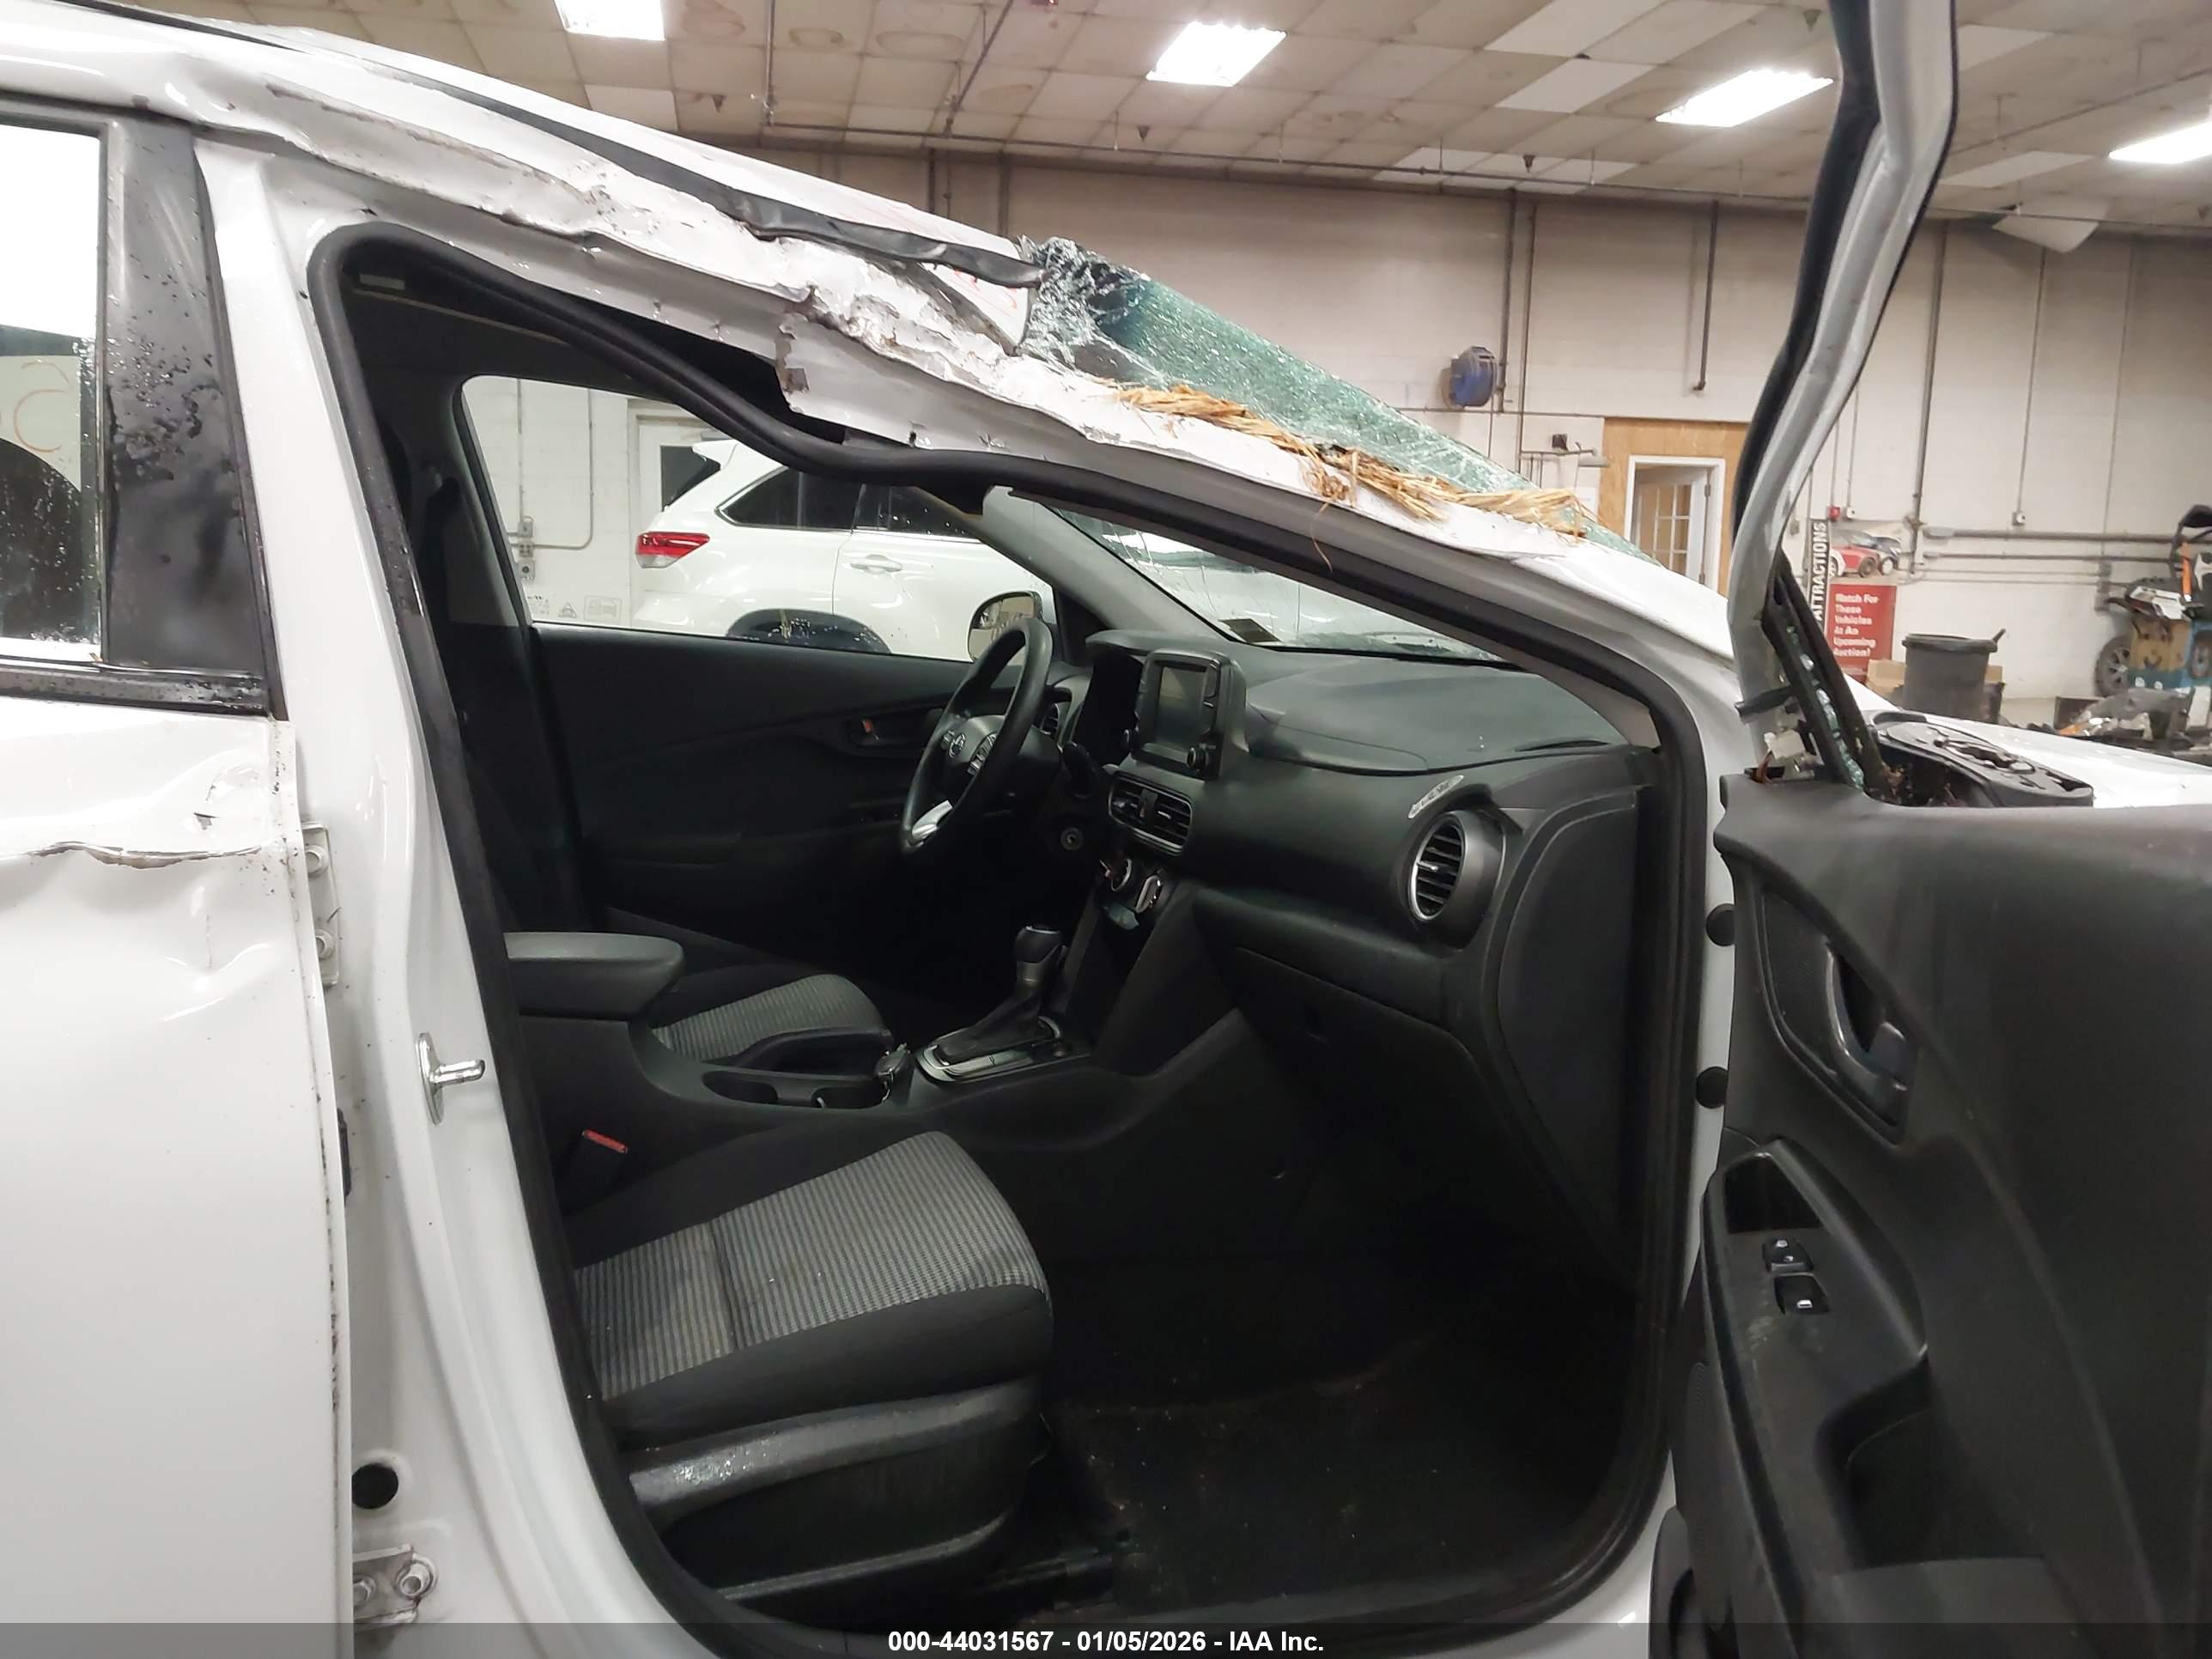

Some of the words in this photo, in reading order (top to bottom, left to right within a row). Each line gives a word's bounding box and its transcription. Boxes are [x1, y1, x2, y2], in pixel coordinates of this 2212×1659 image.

[1810, 522, 1827, 621] ATTRACTIONS
[1863, 593, 1879, 604] For
[1835, 604, 1862, 614] These
[1834, 615, 1873, 625] Vehicles
[1833, 636, 1876, 649] Upcoming
